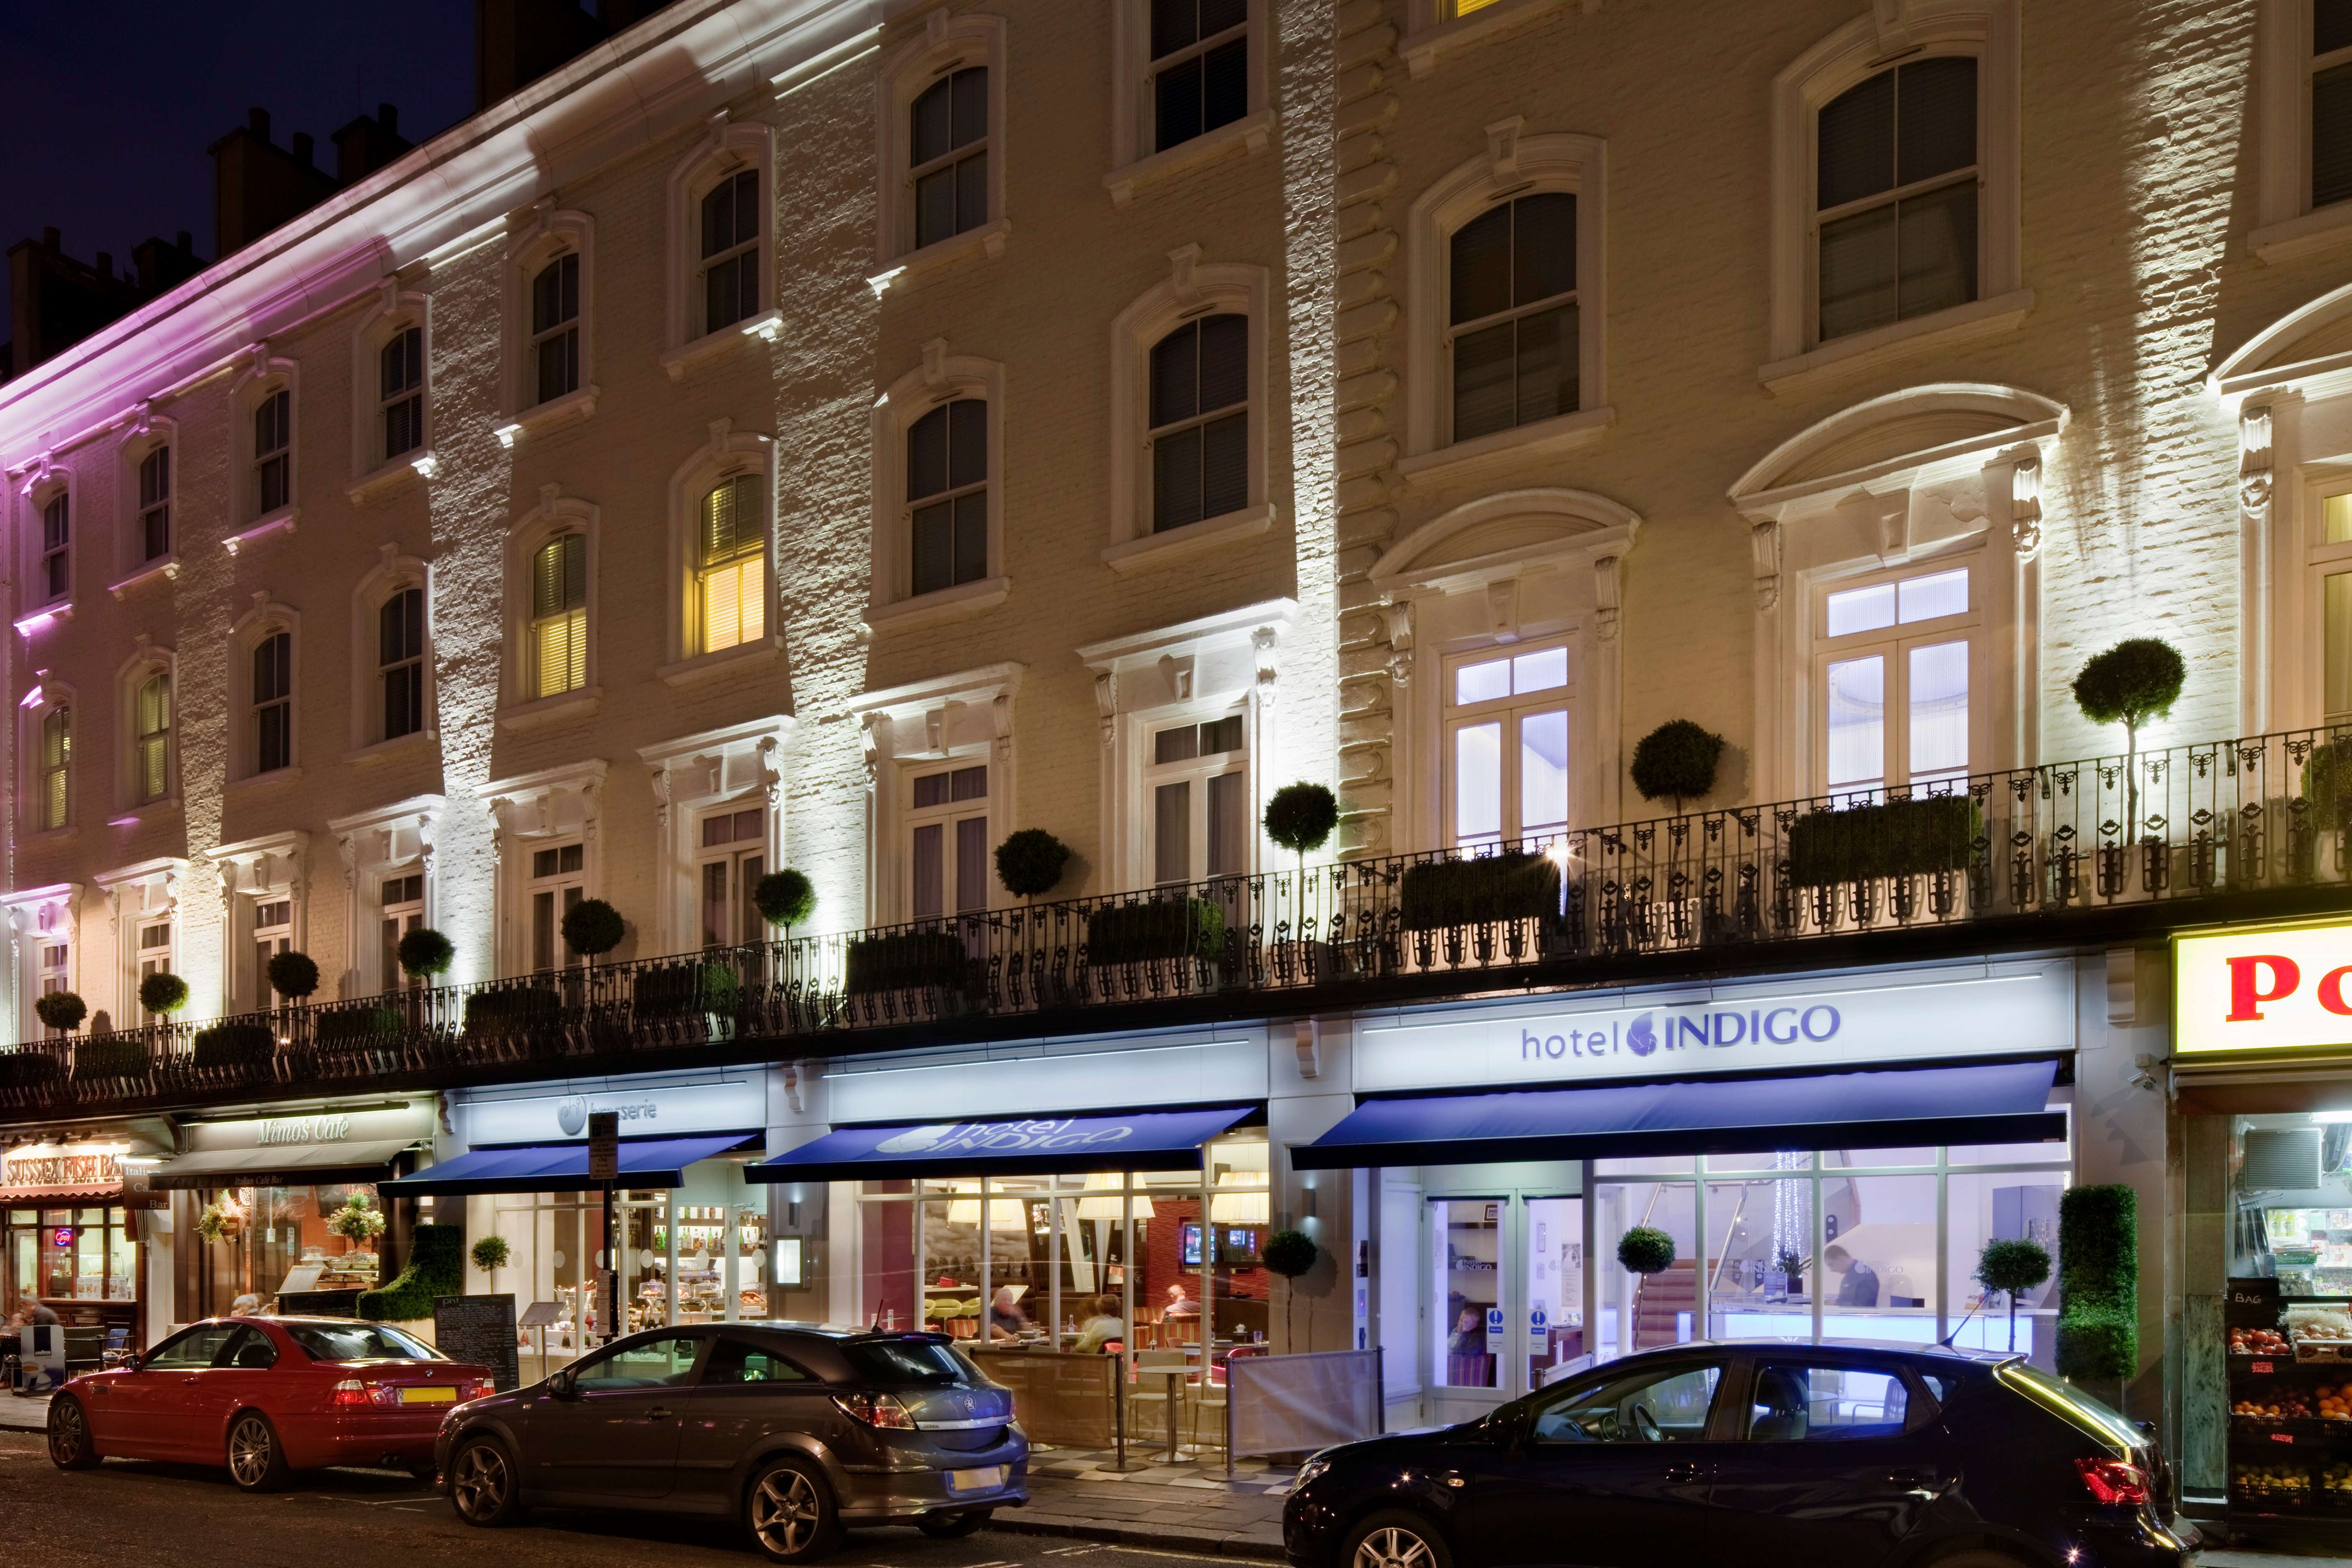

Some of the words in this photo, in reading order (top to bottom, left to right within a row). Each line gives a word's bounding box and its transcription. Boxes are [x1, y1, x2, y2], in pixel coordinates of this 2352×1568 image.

[1522, 1021, 1618, 1058] hotel
[1665, 1005, 1841, 1049] INDIGO
[256, 1119, 311, 1143] Mimo's
[955, 1116, 1077, 1138] hotel
[923, 1127, 1133, 1152] INDIGO
[8, 1157, 61, 1182] SUSSEX
[62, 1155, 97, 1179] FISH
[99, 1153, 123, 1177] BA
[235, 1176, 254, 1185] Italian
[271, 1175, 283, 1184] Bar
[150, 1200, 168, 1209] Bar
[55, 1233, 71, 1243] Open
[2235, 1292, 2262, 1305] BAG
